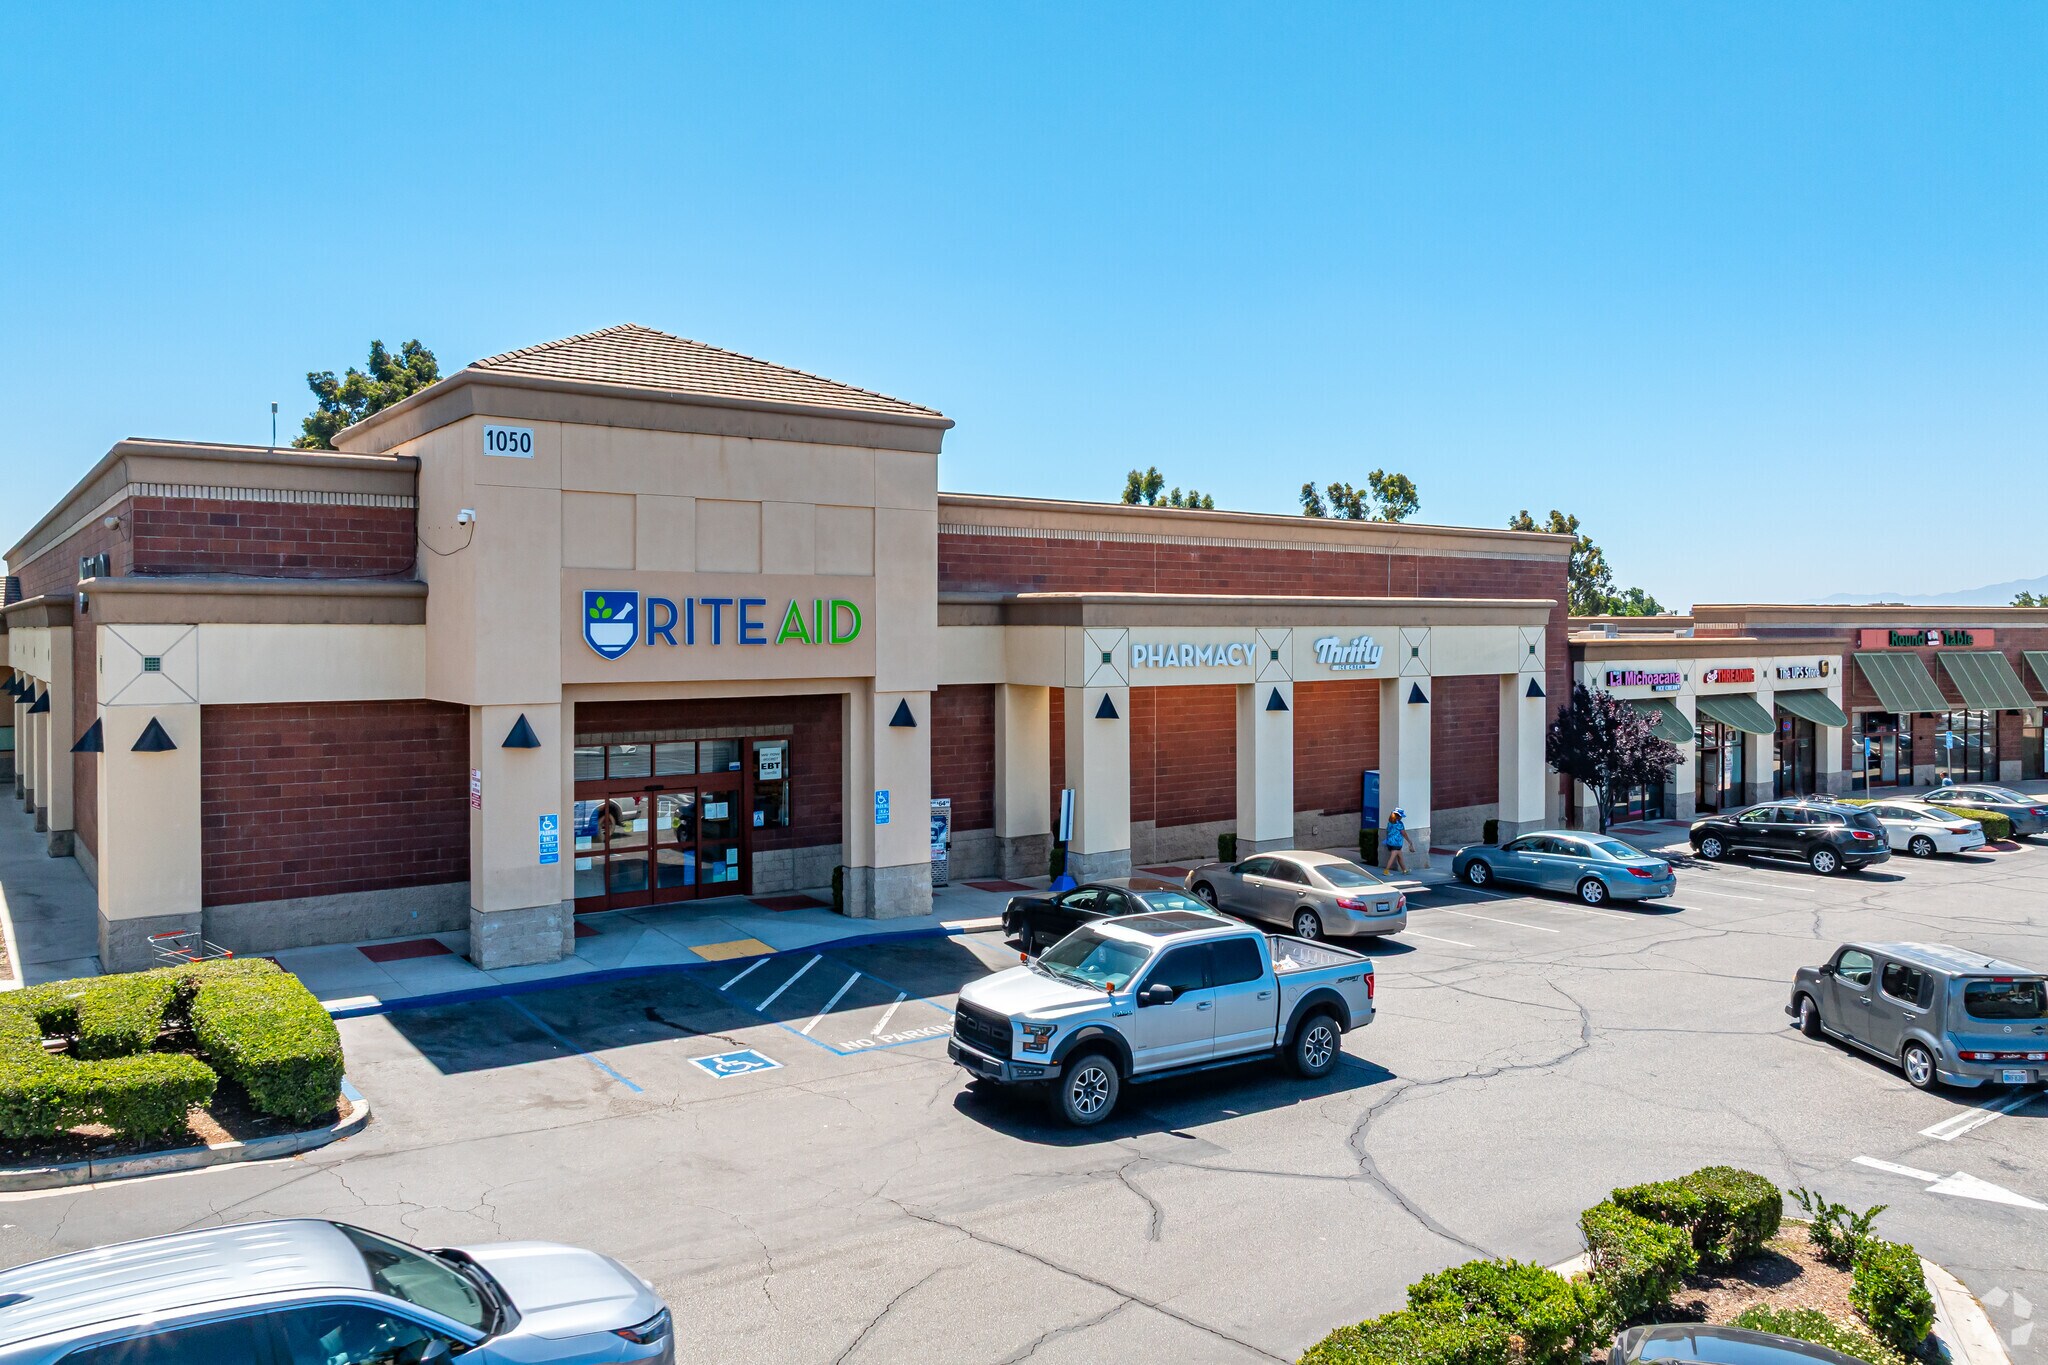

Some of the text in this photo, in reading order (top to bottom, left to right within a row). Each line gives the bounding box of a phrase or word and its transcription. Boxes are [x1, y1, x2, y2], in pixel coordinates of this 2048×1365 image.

[485, 429, 532, 454] 1050
[645, 597, 863, 647] RITE AID
[1889, 630, 1974, 647] Round Table
[1131, 643, 1257, 669] PHARMACY
[1313, 635, 1384, 668] Thrifty
[1608, 671, 1681, 687] La Michoacana
[1717, 668, 1755, 683] THREADING
[1779, 666, 1820, 680] The UPS Store
[761, 762, 780, 770] EBT
[838, 1022, 955, 1050] NO PARKIN
[957, 1011, 1006, 1040] FORD
